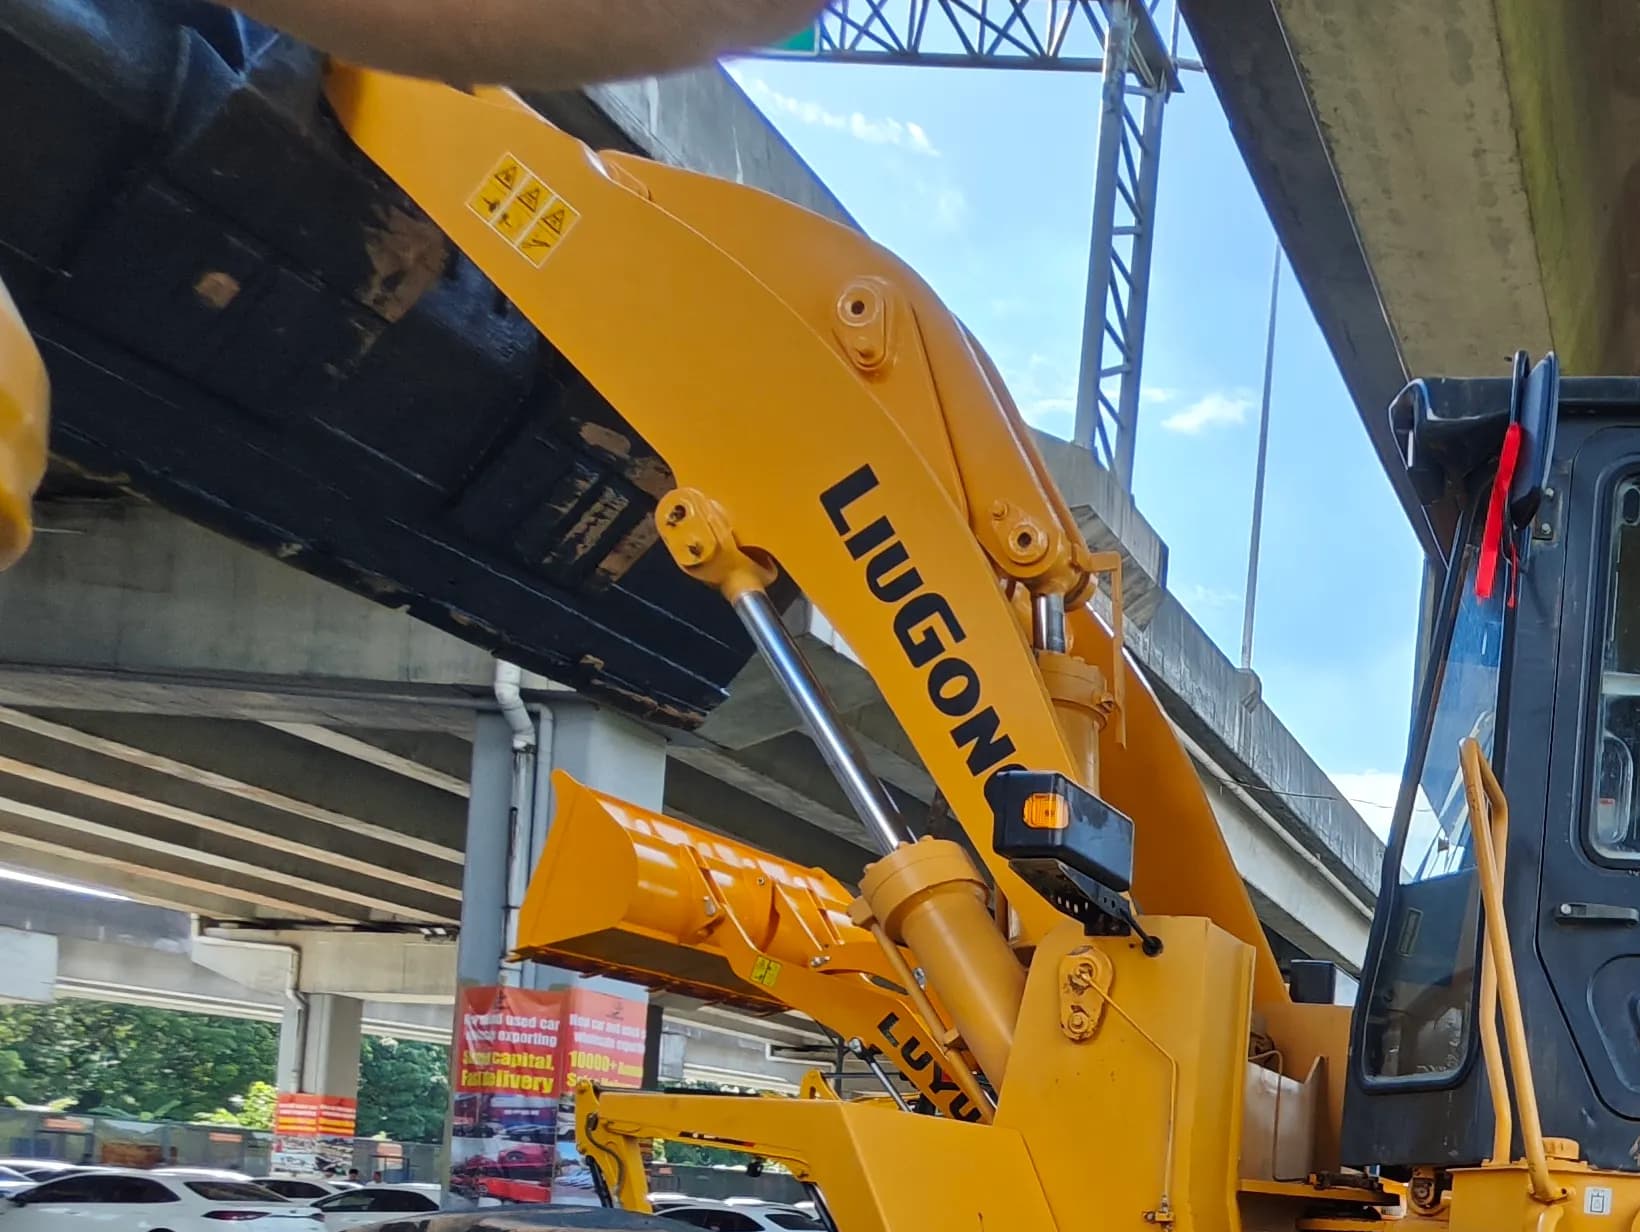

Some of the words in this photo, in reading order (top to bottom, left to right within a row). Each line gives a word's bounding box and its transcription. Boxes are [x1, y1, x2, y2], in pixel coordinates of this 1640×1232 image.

[819, 463, 1029, 814] LIUGON
[505, 1014, 537, 1028] used
[539, 1017, 560, 1032] car
[497, 1030, 558, 1047] exporting
